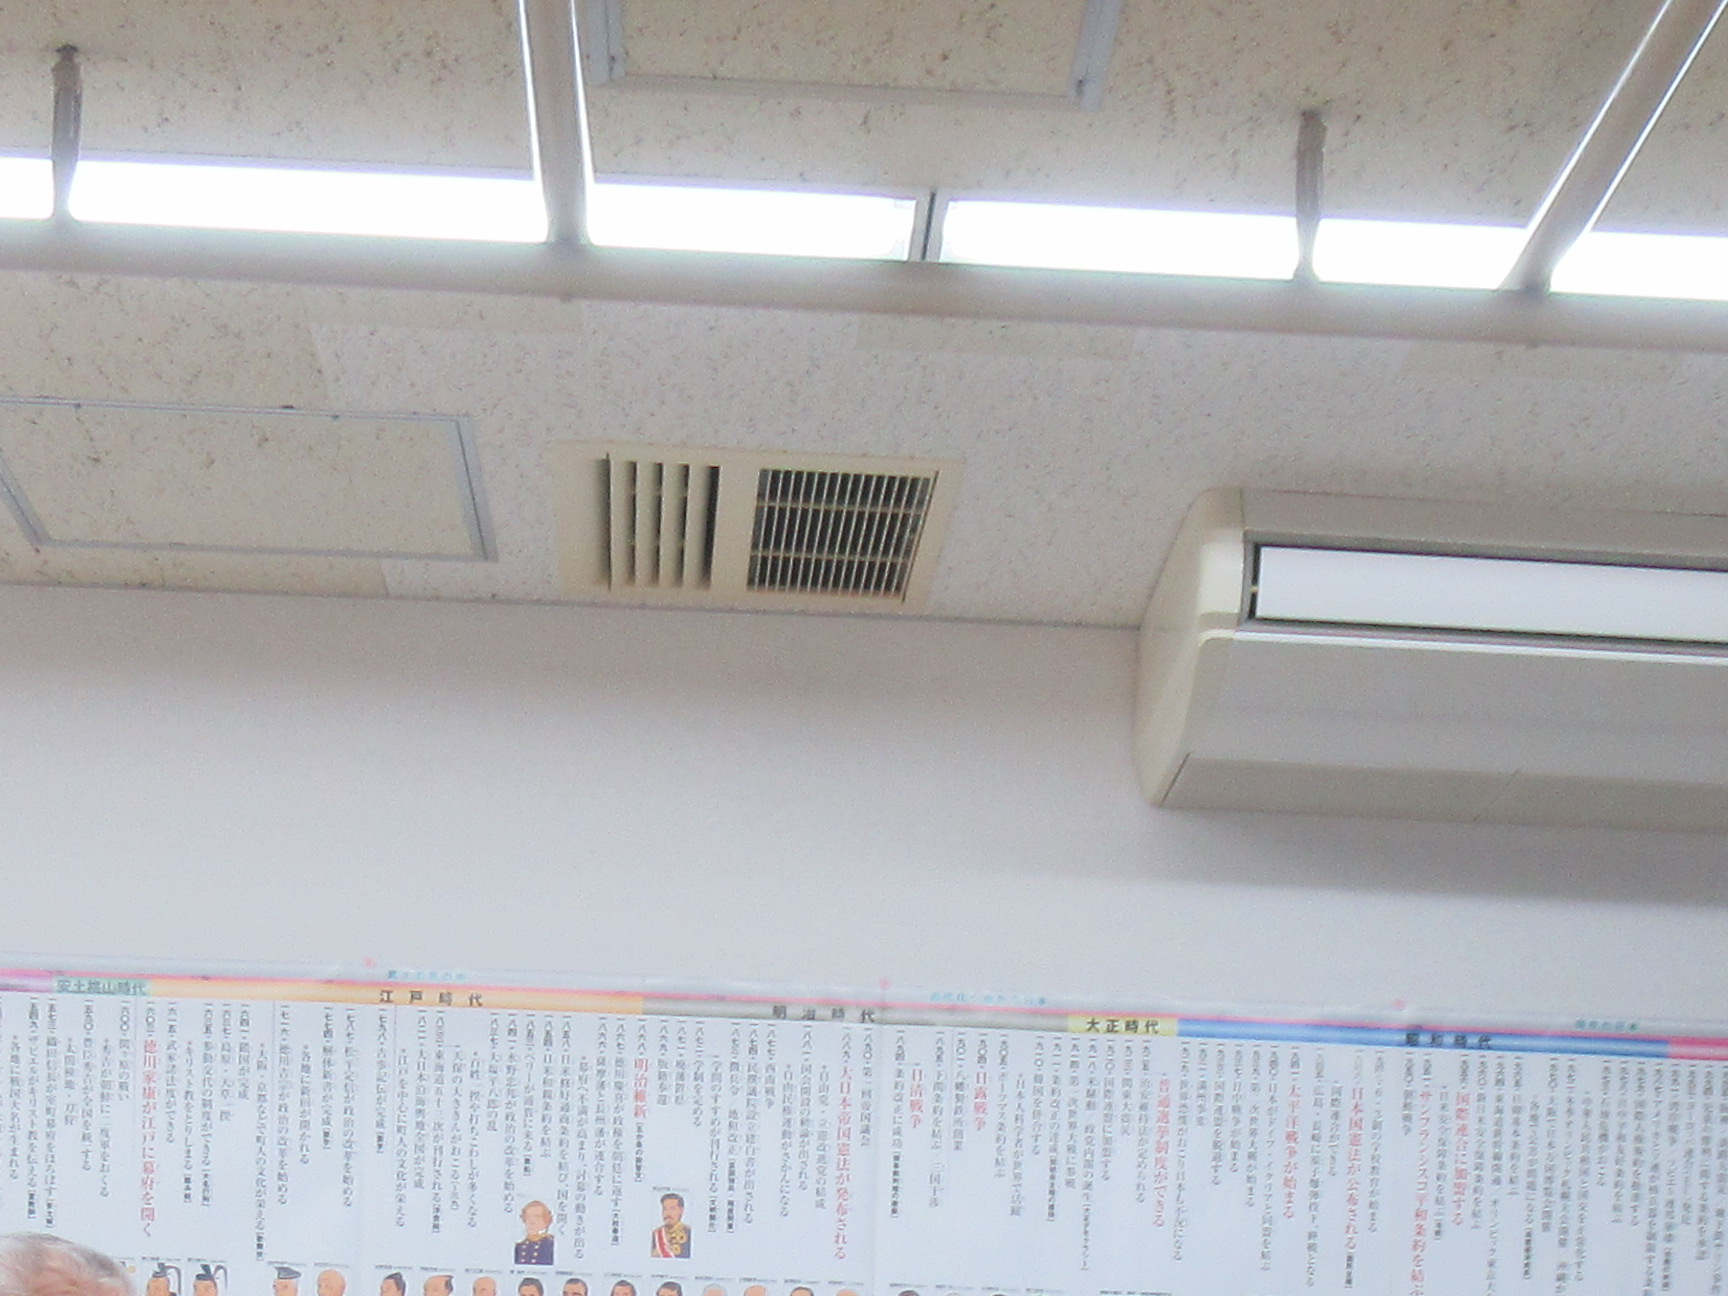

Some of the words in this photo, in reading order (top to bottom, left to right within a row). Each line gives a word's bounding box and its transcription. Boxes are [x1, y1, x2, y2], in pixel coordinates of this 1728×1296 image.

[56, 977, 148, 995] 安土桃山時代
[379, 990, 484, 1007] 江戸時代
[773, 1003, 876, 1025] 明治時代
[1085, 1017, 1161, 1034] 大正時代
